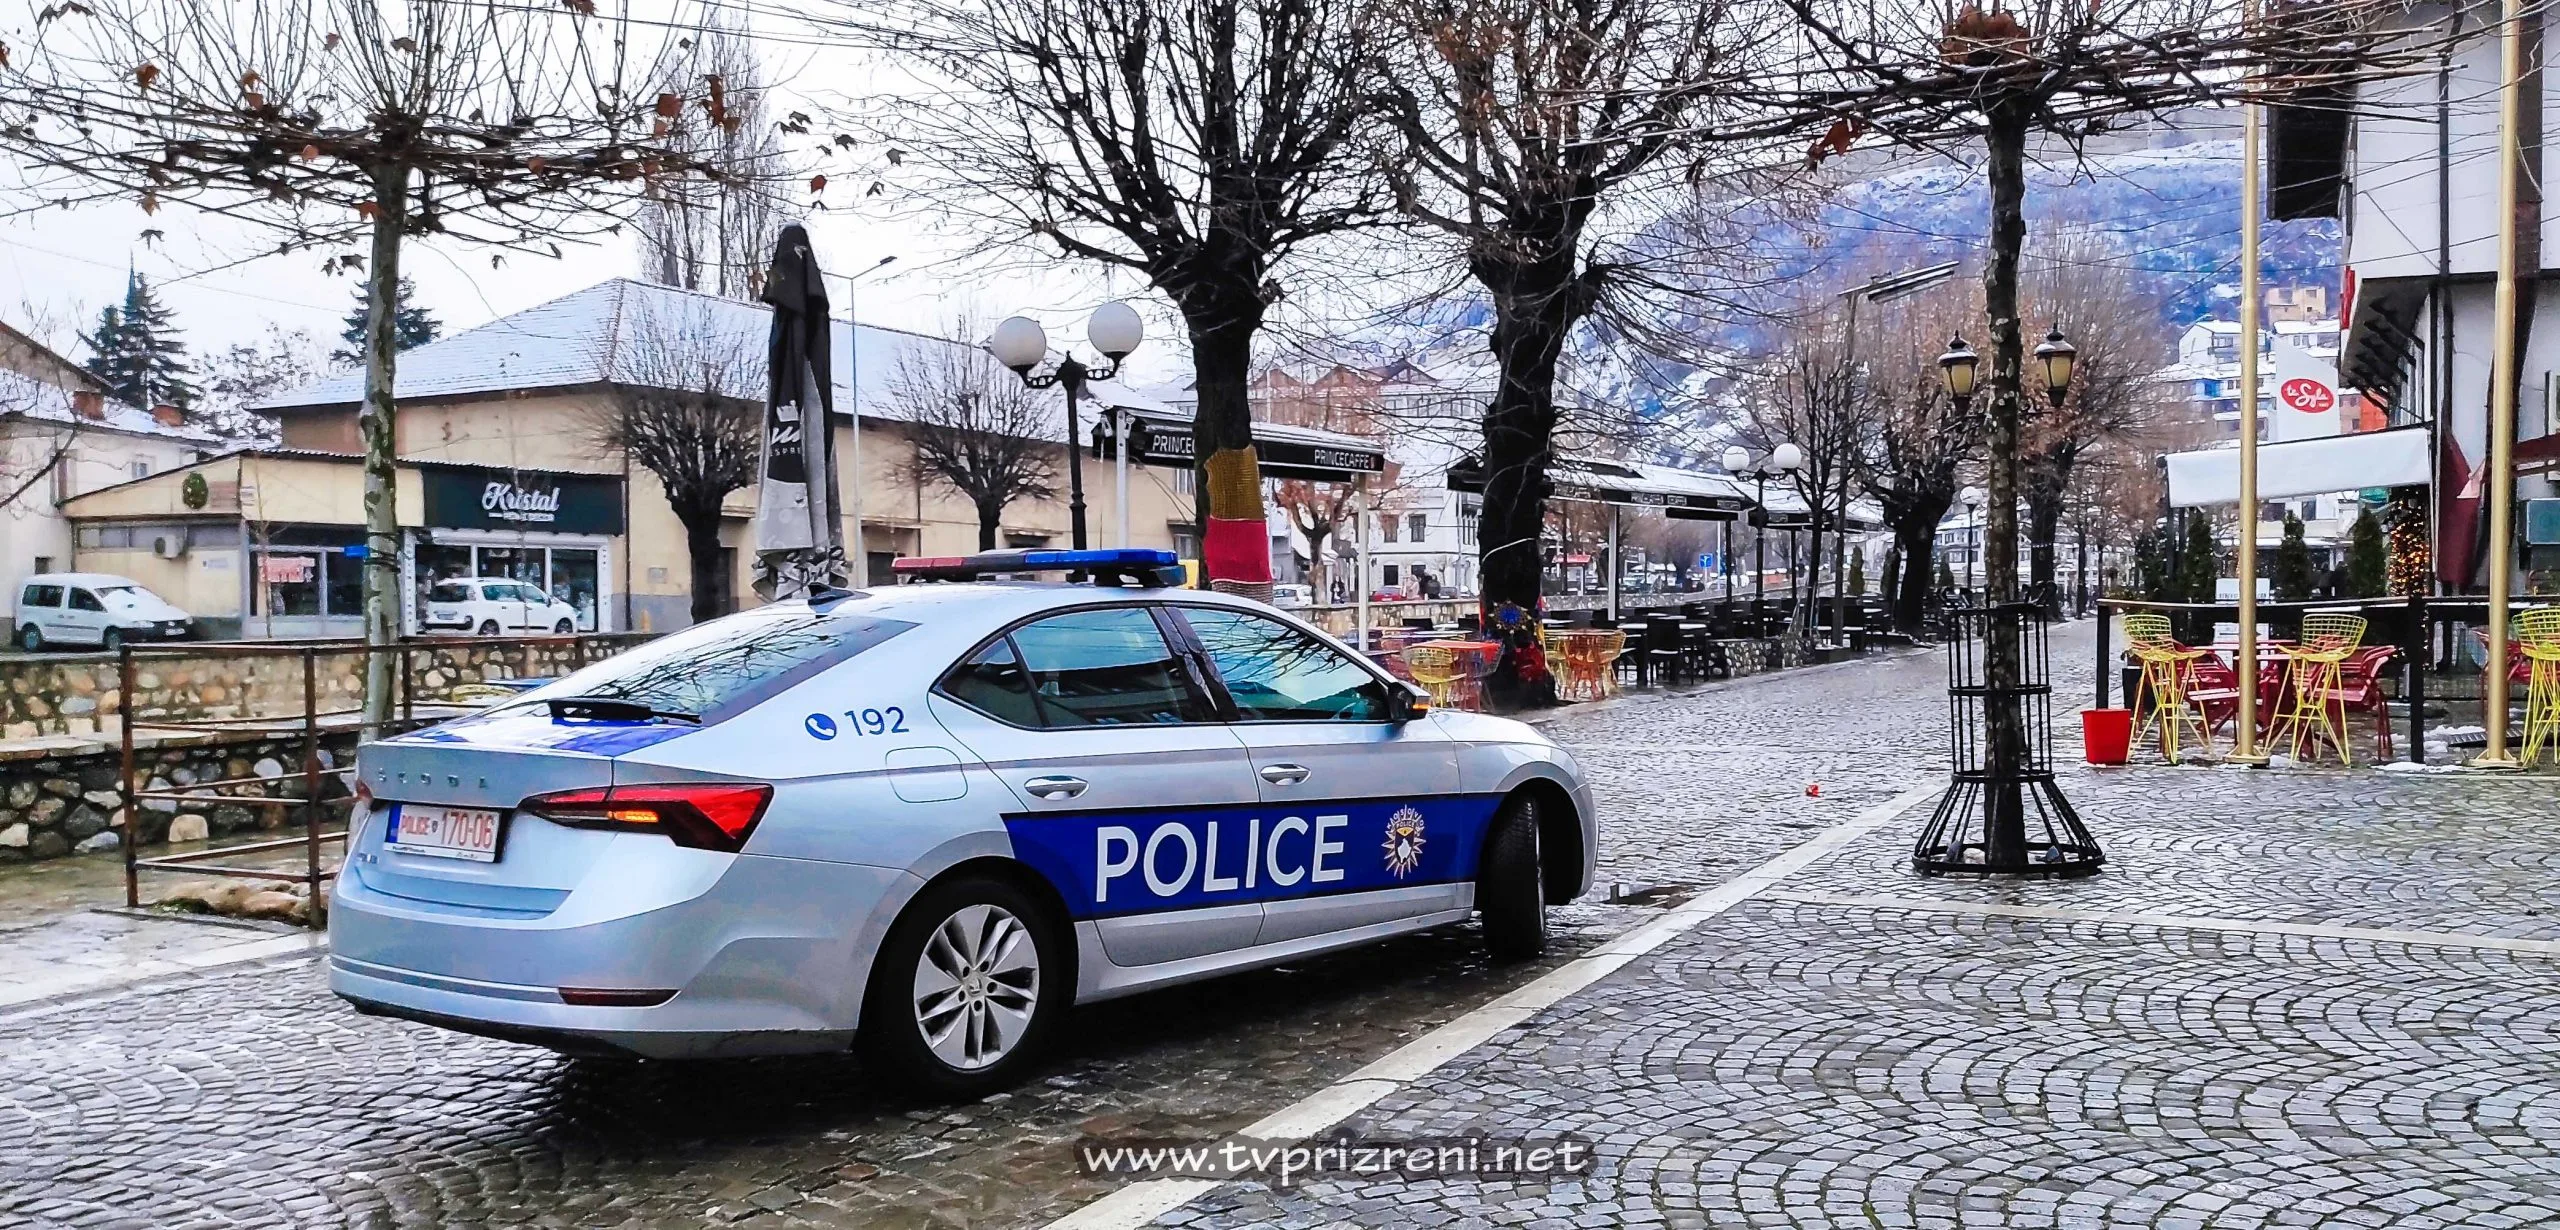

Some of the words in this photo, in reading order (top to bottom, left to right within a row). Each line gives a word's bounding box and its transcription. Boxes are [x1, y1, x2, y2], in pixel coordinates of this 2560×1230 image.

[1314, 449, 1370, 469] PRINCECAFFE
[482, 482, 561, 511] Kristal
[844, 706, 909, 736] 192
[441, 809, 494, 849] 170-06
[1096, 814, 1348, 902] POLICE
